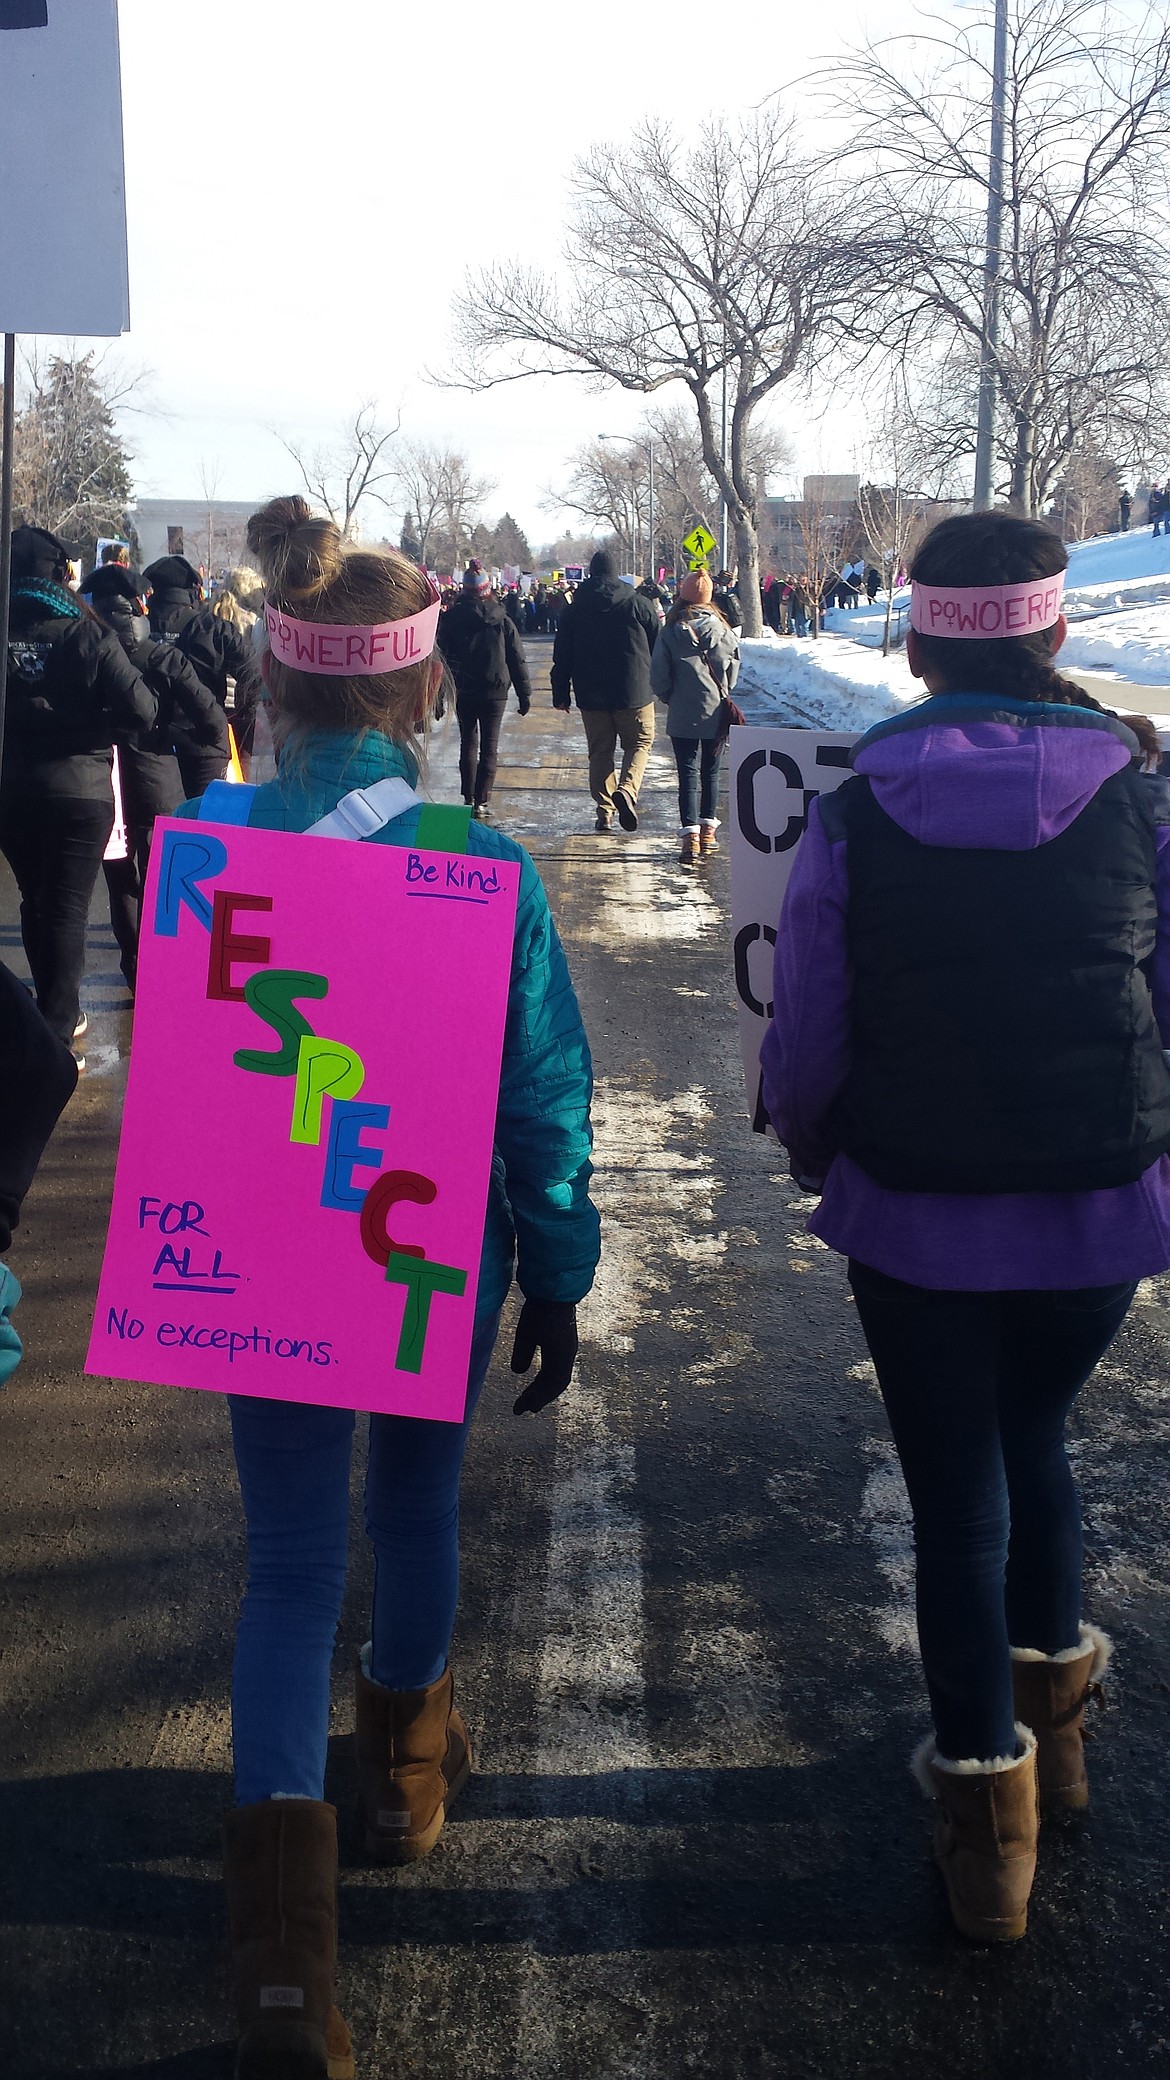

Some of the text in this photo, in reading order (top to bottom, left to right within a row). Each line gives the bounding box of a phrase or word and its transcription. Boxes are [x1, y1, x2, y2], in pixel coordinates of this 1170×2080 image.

[405, 853, 440, 882] Be
[154, 829, 468, 1375] RESPECT
[138, 1195, 212, 1238] FOR
[106, 1306, 340, 1367] No exceptions.
